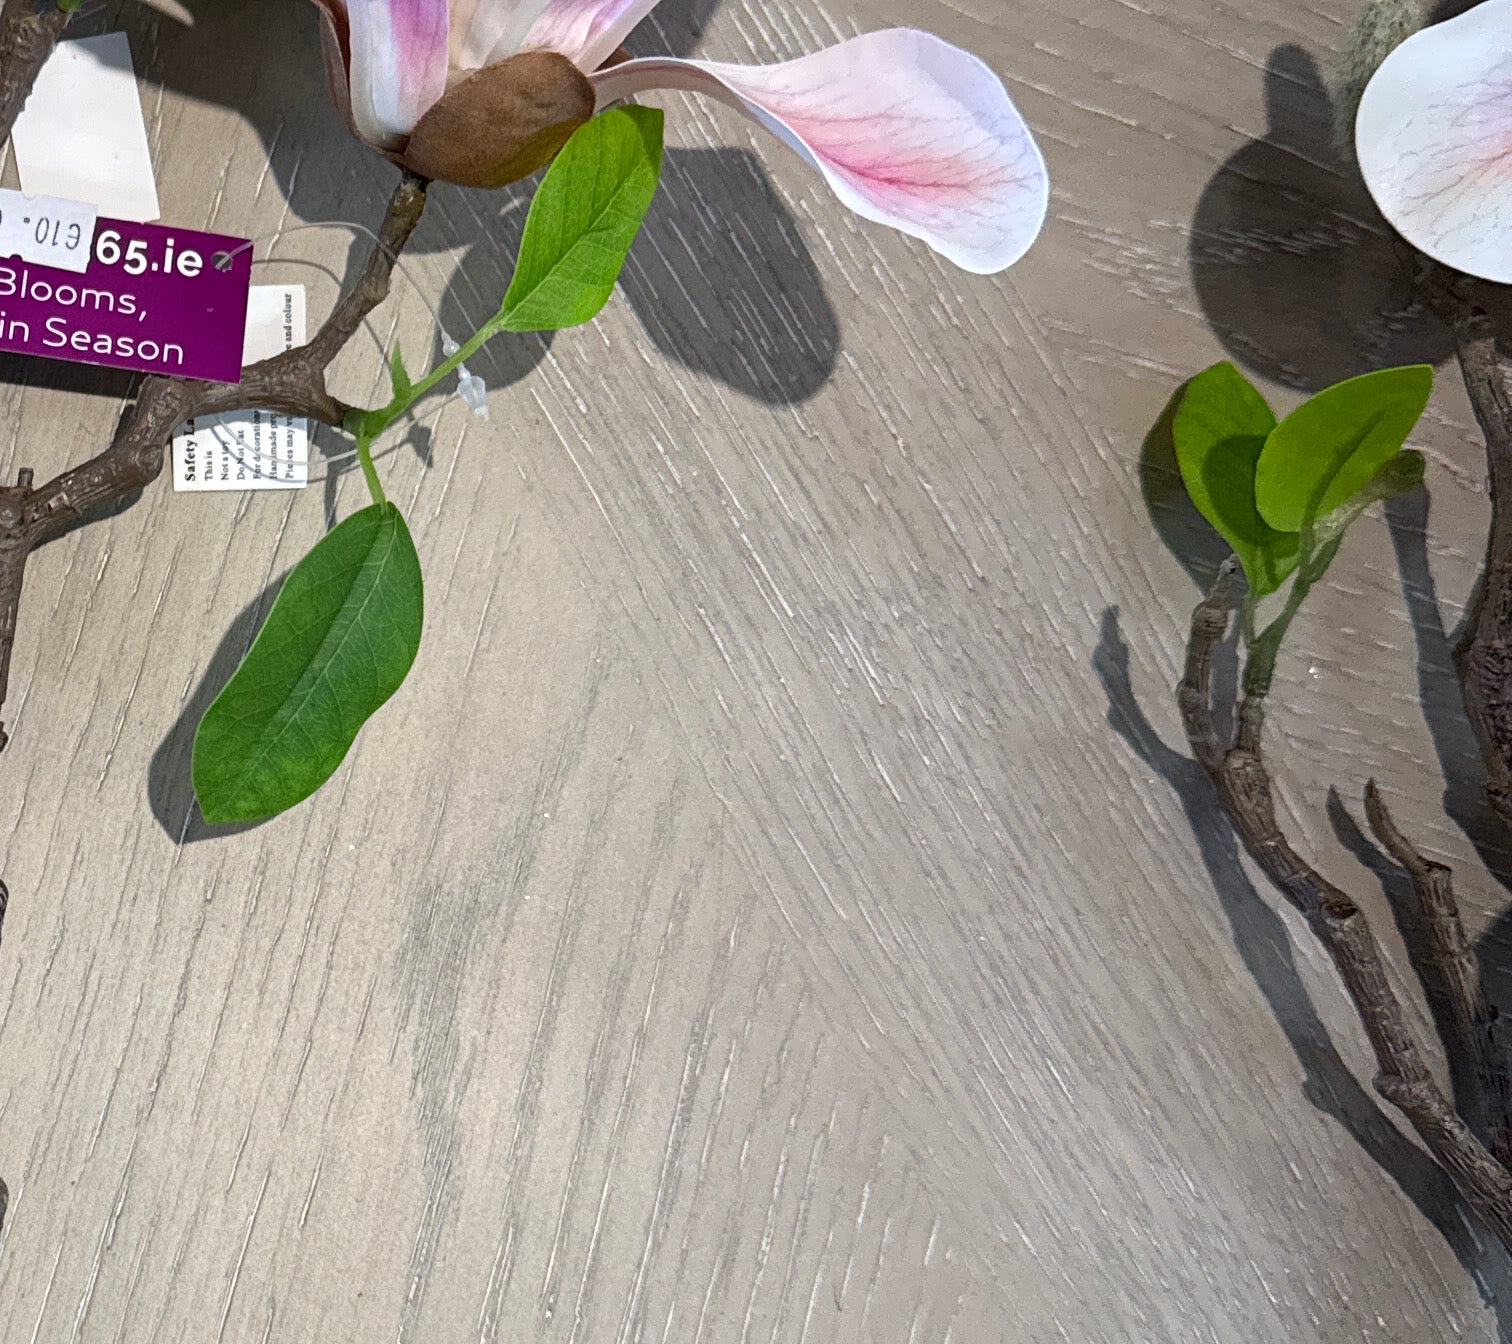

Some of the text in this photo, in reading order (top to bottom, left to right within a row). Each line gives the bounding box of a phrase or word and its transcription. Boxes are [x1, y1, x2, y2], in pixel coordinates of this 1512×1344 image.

[283, 293, 292, 323] colour
[42, 316, 184, 365] Season
[283, 325, 292, 341] and
[287, 429, 295, 446] may
[185, 440, 198, 482] Safety
[236, 448, 245, 464] Not
[285, 450, 294, 479] Piees
[204, 451, 213, 481] This is
[221, 465, 229, 481] Not
[237, 467, 245, 480] Do
[253, 465, 261, 480] For
